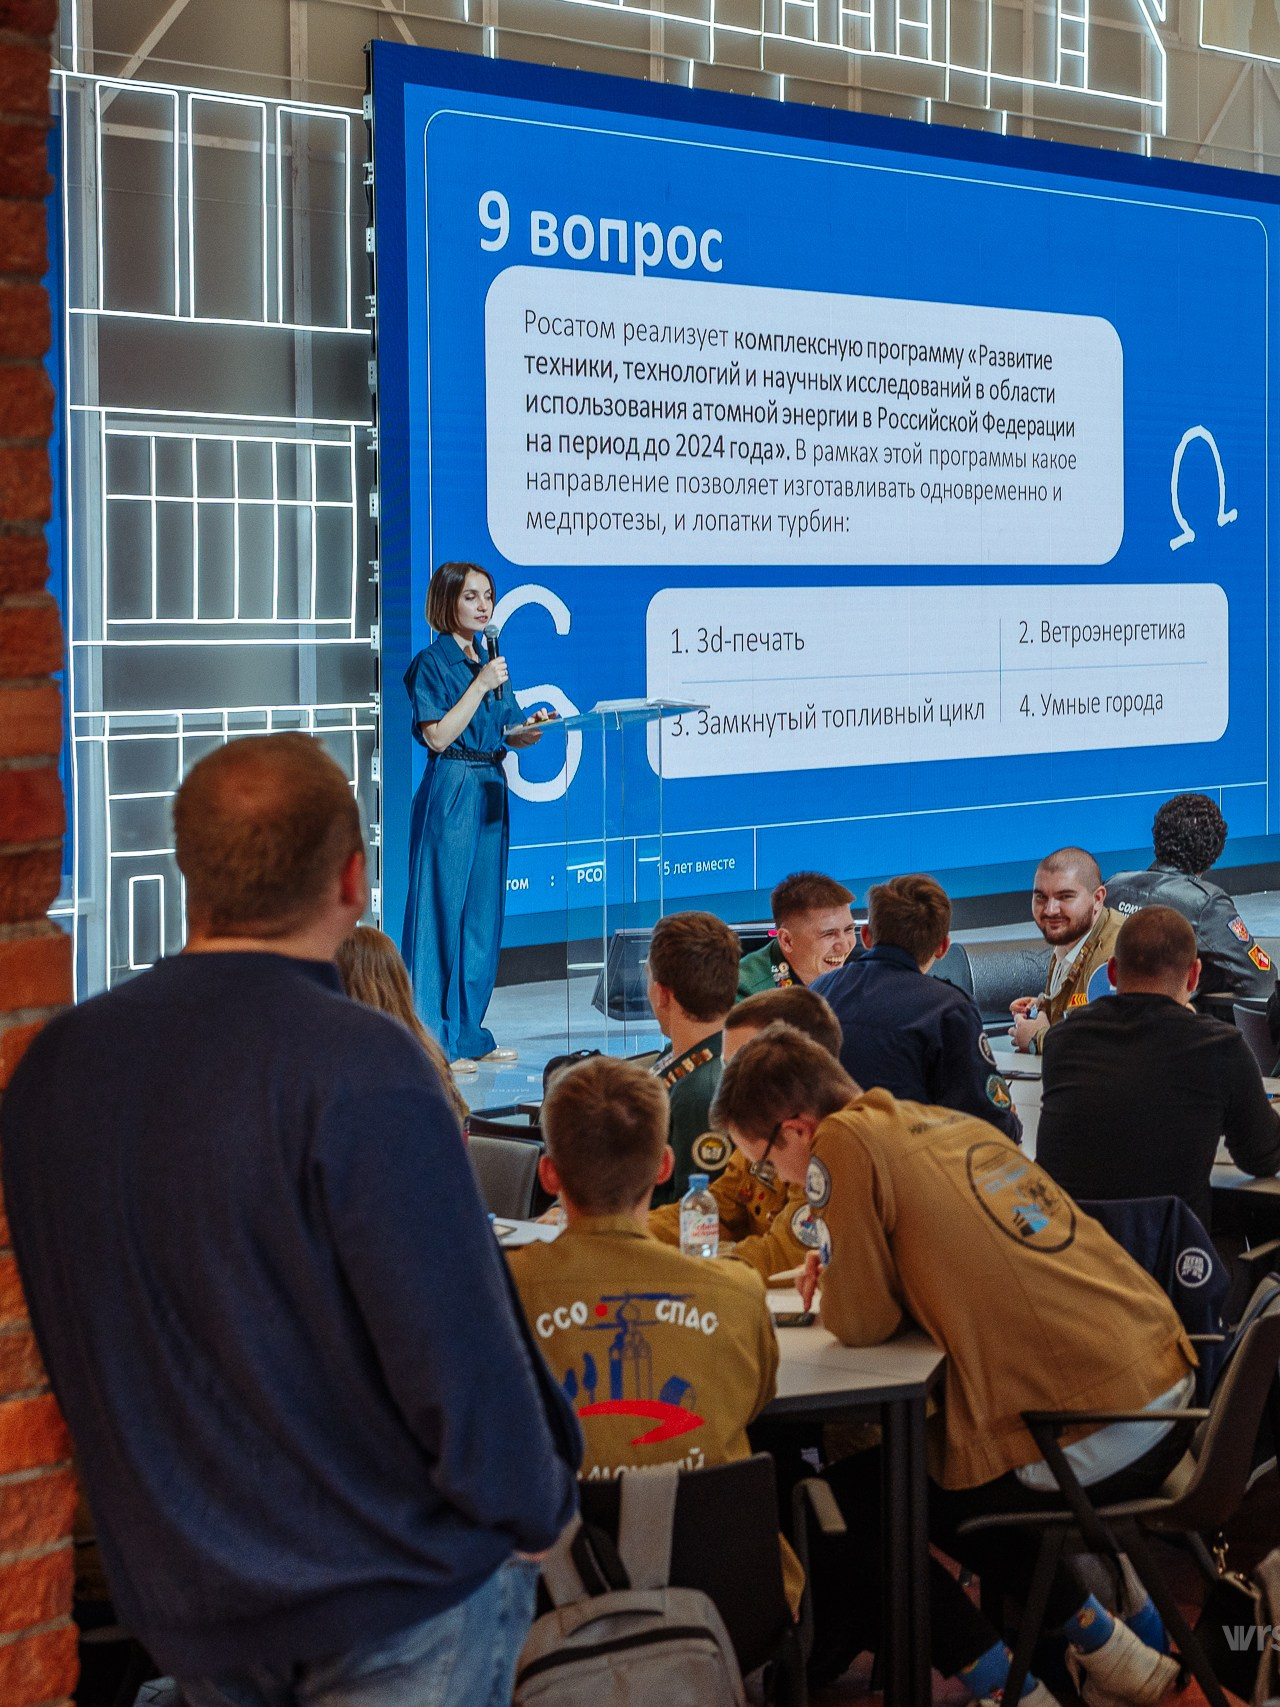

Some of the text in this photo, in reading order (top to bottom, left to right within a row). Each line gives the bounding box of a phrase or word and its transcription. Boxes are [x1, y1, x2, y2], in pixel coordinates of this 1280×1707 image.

[478, 190, 723, 277] 9 вопрос
[525, 309, 1053, 370] Росатом реализует комплексную программу «Развитие
[524, 355, 1055, 404] техники, технологий и научных исследований в области
[526, 394, 1075, 441] использования атомной энергии в Российской Федерации
[526, 433, 1077, 471] на период до 2024 года». В рамках этой программы какое
[526, 472, 1062, 505] направление позволяет изготавливать одновременно и
[526, 509, 850, 538] медпротезы, и лопатки турбин:
[671, 626, 805, 654] 1. 3d-печать
[1019, 620, 1185, 648] 2. Ветроэнергетика
[697, 703, 816, 738] Замкнутый
[821, 697, 934, 728] топливный
[939, 701, 985, 727] цикл
[1019, 693, 1163, 718] 4. Умные города
[577, 867, 602, 883] РСО
[673, 862, 693, 875] лет
[695, 857, 736, 872] вместе
[536, 1299, 720, 1338] ССО СПАС
